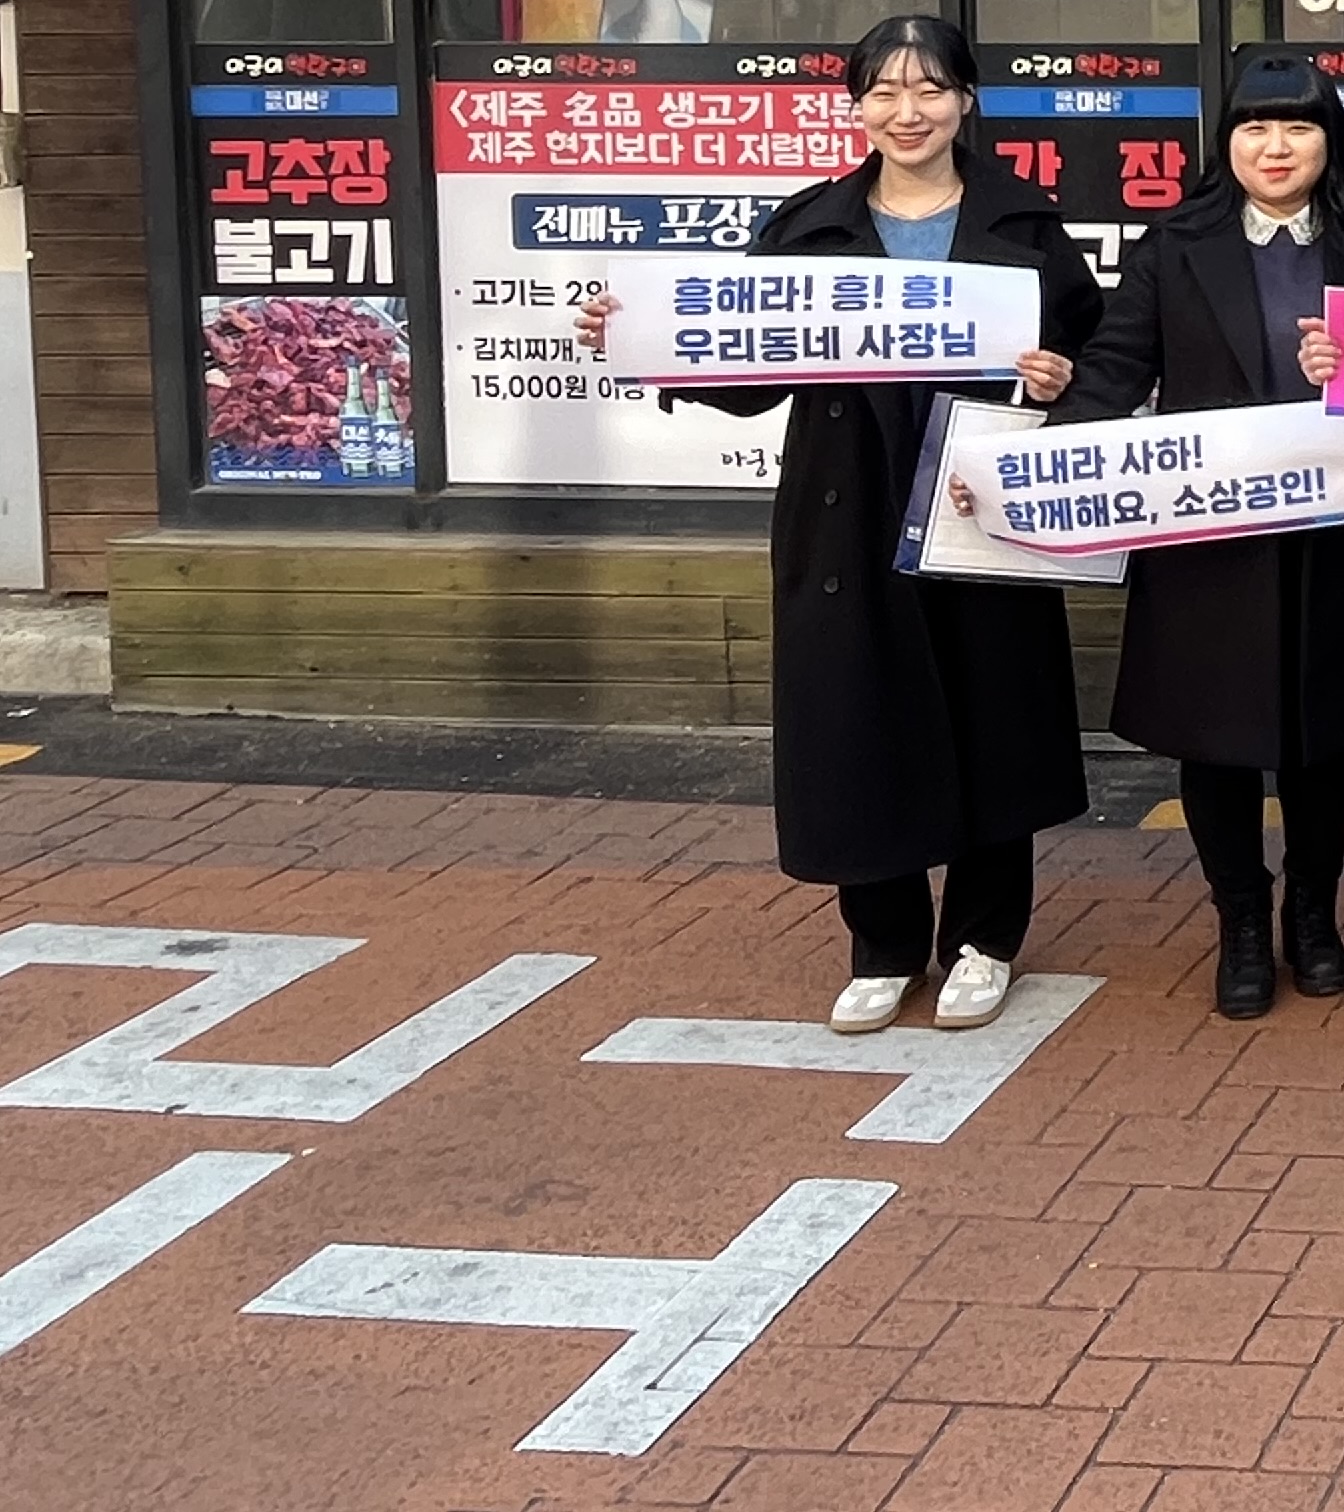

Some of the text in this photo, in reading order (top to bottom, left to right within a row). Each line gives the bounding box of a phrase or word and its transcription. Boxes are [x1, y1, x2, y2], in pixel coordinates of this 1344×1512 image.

[226, 55, 283, 76] 아궁이
[493, 55, 552, 76] 아궁이
[736, 55, 796, 76] 아궁이
[1011, 55, 1072, 78] 아궁이
[564, 90, 642, 128] 名品
[656, 91, 774, 130] 생고기
[467, 132, 536, 164] 제주
[545, 131, 684, 166] 현지보다
[694, 132, 727, 166] 더
[209, 138, 392, 204] 고추장
[530, 204, 645, 245] 전메뉴
[213, 218, 394, 284] 불고기
[471, 279, 556, 307] 고기는
[674, 275, 953, 317] 흥해라! 흥! 흥!
[473, 336, 582, 364] 김치찌개,
[674, 321, 977, 365] 우리동네 사장님
[471, 374, 588, 401] 15,000원
[996, 434, 1204, 490] 힘내라 사하!
[1002, 467, 1327, 534] 함께해요, 소상공인!
